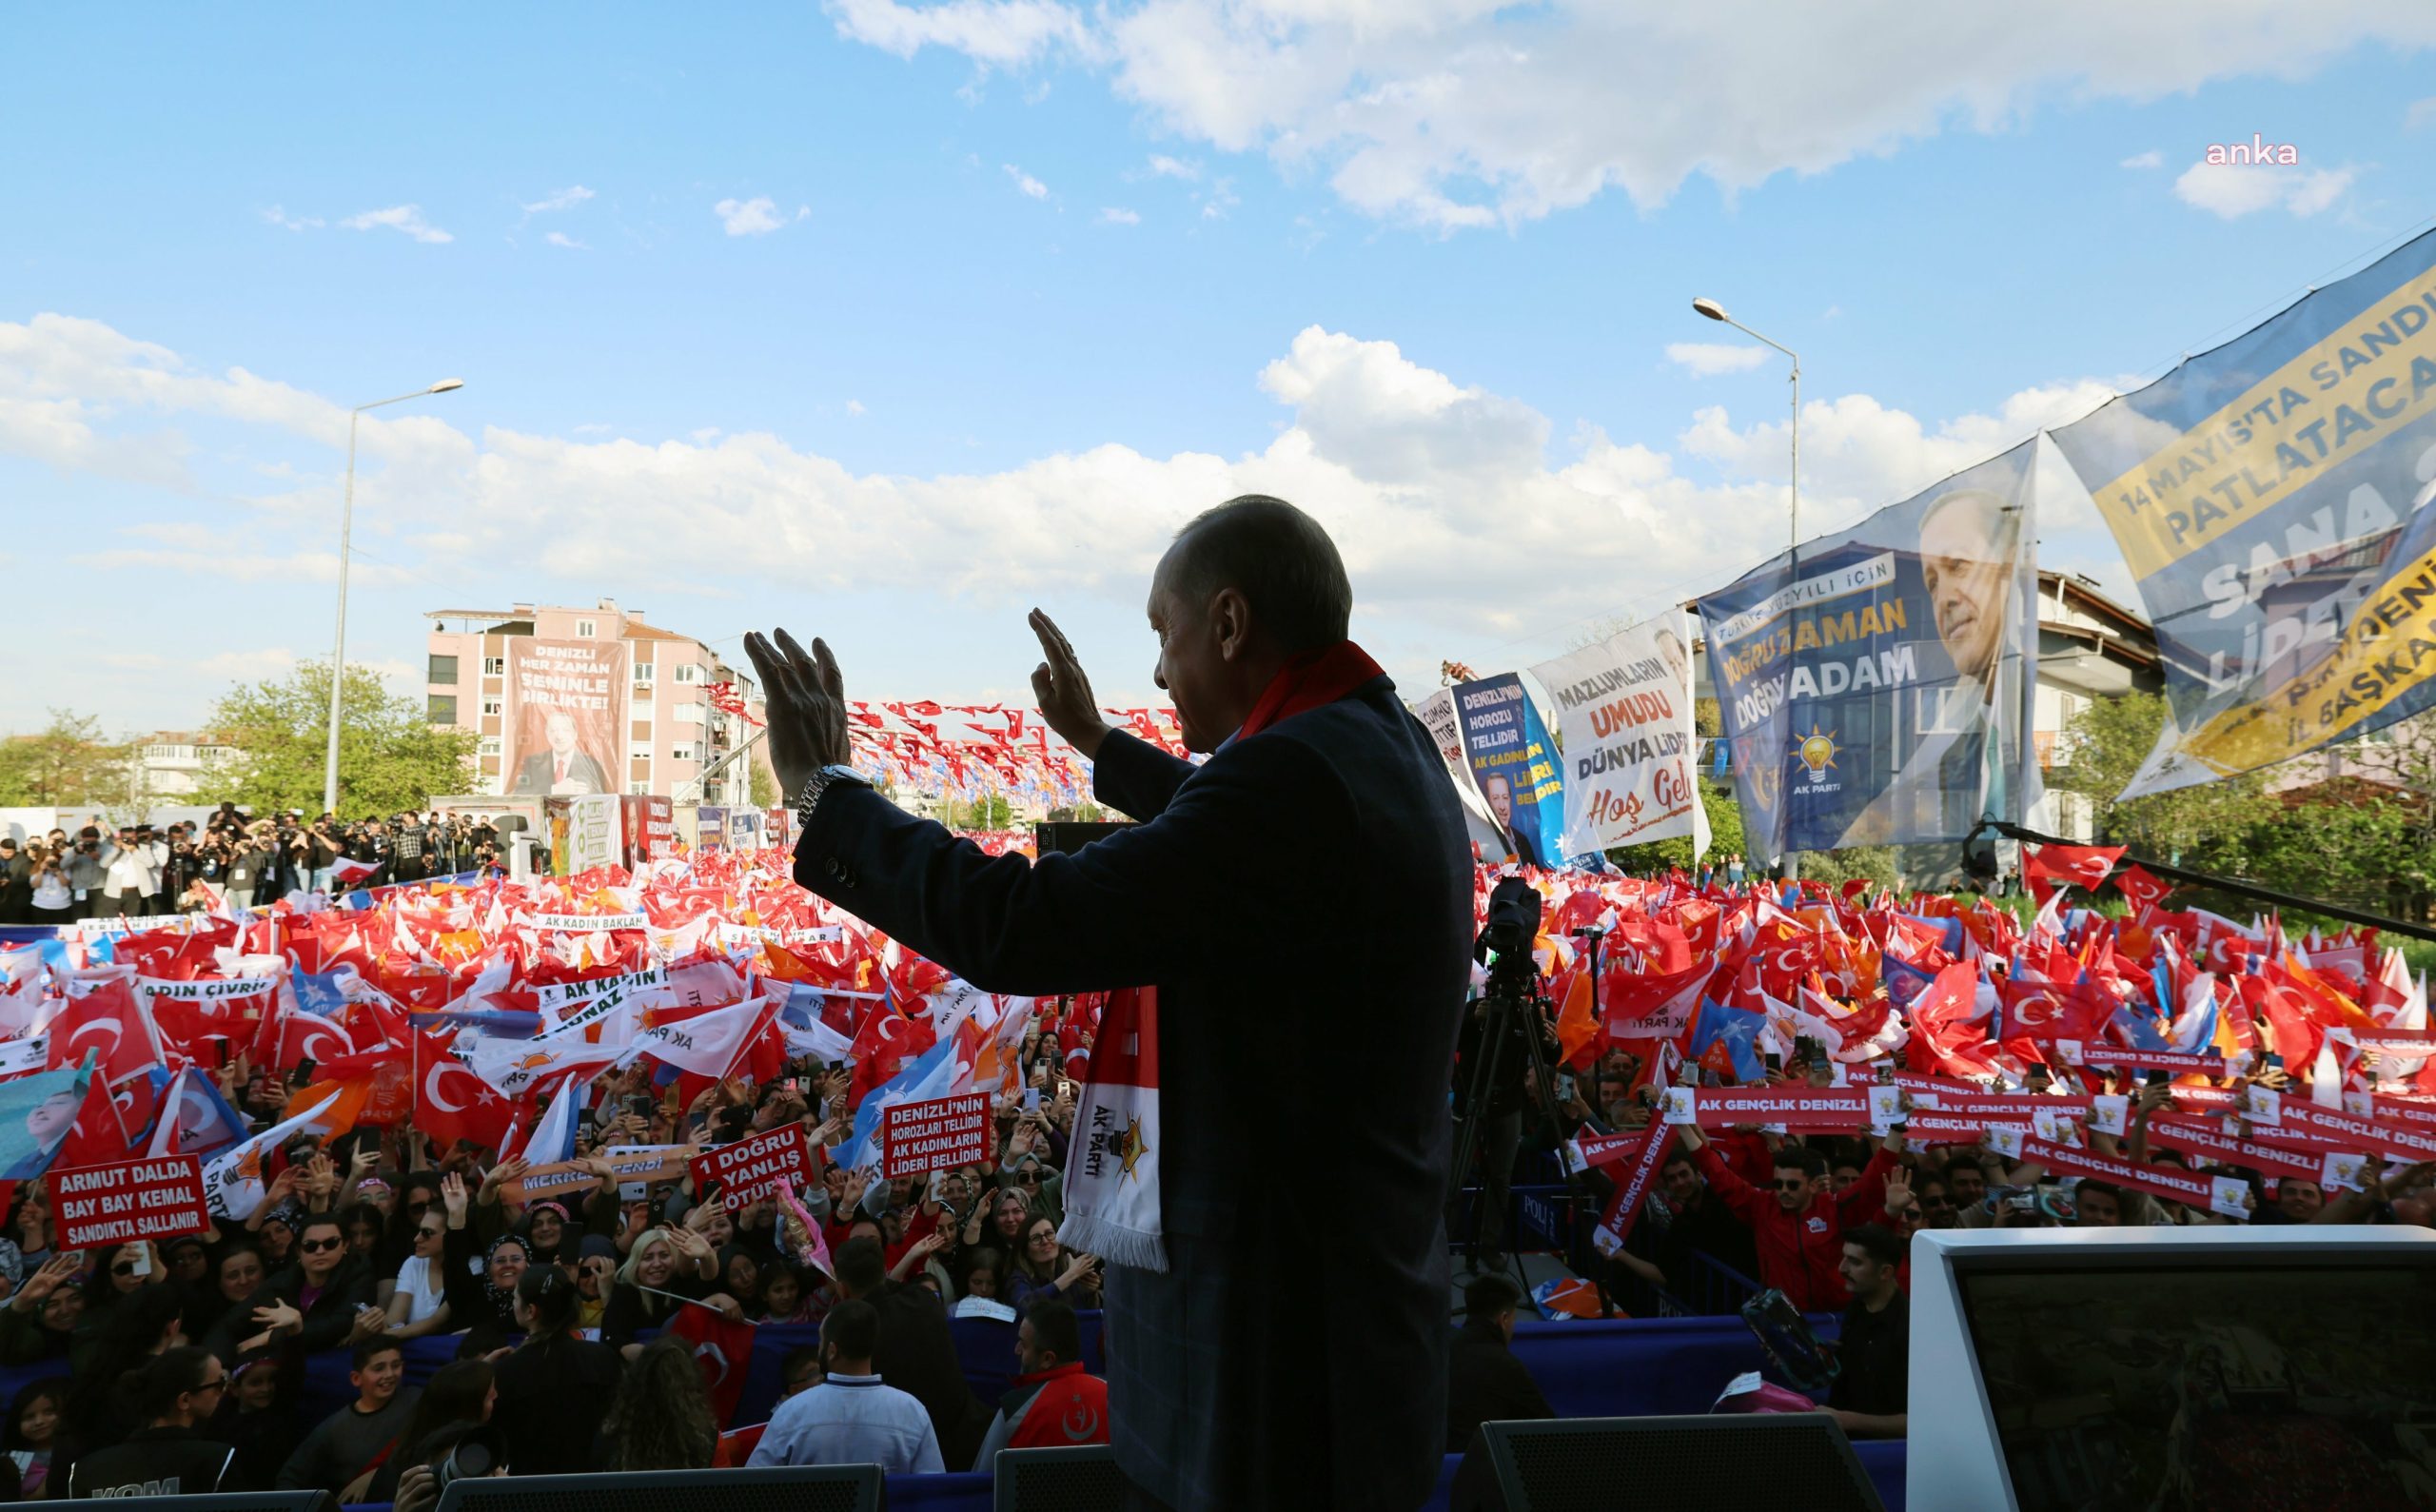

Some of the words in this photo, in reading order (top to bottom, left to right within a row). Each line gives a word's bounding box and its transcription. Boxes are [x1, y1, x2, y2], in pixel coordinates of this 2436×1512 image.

[2120, 485, 2152, 516] 14
[2309, 284, 2436, 392] SANDI
[2201, 481, 2399, 619] SANA
[1847, 562, 1888, 587] İÇİN
[1722, 634, 1777, 687] DOĞRU
[1777, 598, 1908, 656] ZAMAN
[520, 657, 550, 671] HER
[554, 660, 610, 674] ZAMAN
[1788, 646, 1917, 699] ADAM
[1557, 658, 1669, 712] MAZLUMLARIN
[1469, 709, 1513, 731] HOROZU
[1589, 689, 1674, 739] UMUDU
[1471, 729, 1520, 750] TELLİDİR
[1474, 756, 1487, 769] AK
[1579, 737, 1656, 781] DÜNYA
[1794, 786, 1810, 795] AK
[1586, 788, 1645, 828] Hoş
[545, 916, 560, 927] AK
[563, 917, 599, 930] KADIN
[146, 984, 198, 998] ADIN
[564, 982, 590, 1000] AK
[1849, 1071, 1869, 1082] AK
[891, 1097, 984, 1125] DENİZLİ'NİN
[1092, 1105, 1110, 1128] AK
[1698, 1099, 1721, 1111] AK
[2282, 1106, 2308, 1122] AK
[891, 1121, 942, 1142] HOROZLARI
[944, 1113, 983, 1132] TELLİDİR
[699, 1159, 712, 1174] 1
[717, 1129, 796, 1169] DOĞRU
[893, 1145, 910, 1159] AK
[913, 1131, 982, 1155] KADINLARIN
[1585, 1142, 1606, 1156] AK
[2024, 1142, 2051, 1158] AK
[722, 1149, 801, 1188] YANLIŞ
[891, 1154, 929, 1175] LİDERİ
[932, 1147, 983, 1168] BELLİDİR
[59, 1168, 127, 1194] ARMUT
[131, 1160, 193, 1184] DALDA
[1610, 1213, 1626, 1233] AK
[1642, 1123, 1669, 1166] DENİZL
[62, 1198, 97, 1220] BAY
[101, 1192, 134, 1214] BAY
[139, 1186, 197, 1208] KEMAL
[67, 1219, 136, 1246] SANDIKTA
[137, 1210, 201, 1235] SALLANIR
